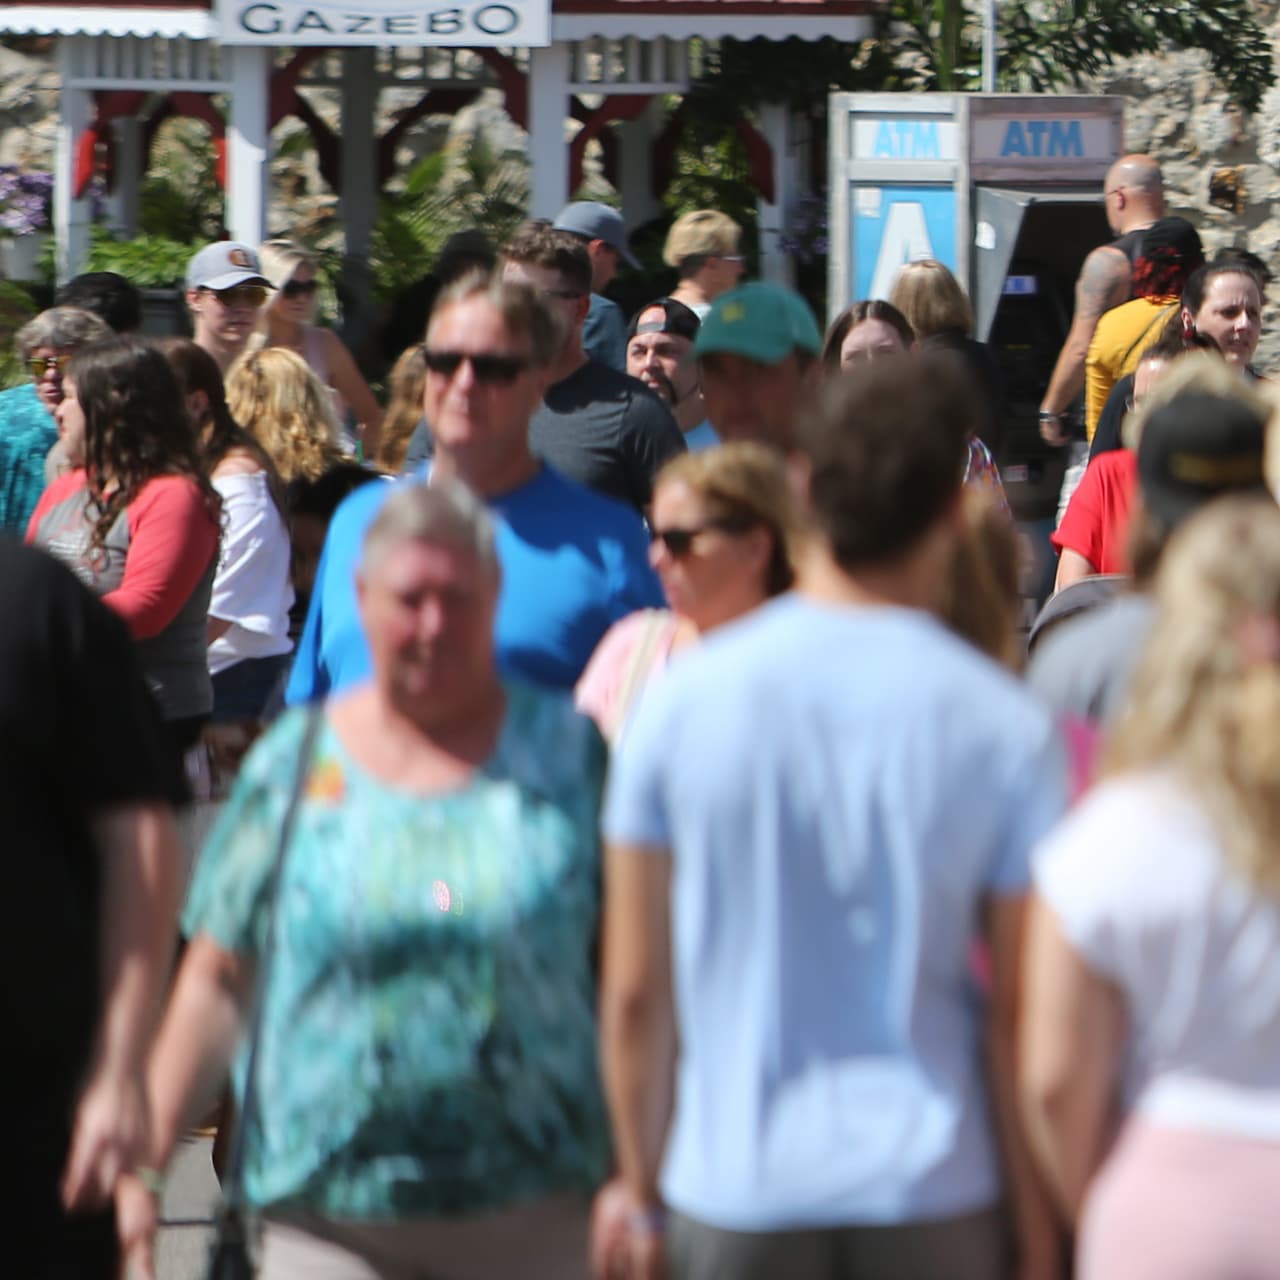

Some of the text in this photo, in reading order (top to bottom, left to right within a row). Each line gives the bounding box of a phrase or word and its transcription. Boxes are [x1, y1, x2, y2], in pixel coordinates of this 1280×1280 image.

[239, 3, 521, 36] GAZEBO
[874, 121, 942, 158] ATM
[1001, 121, 1085, 158] ATM
